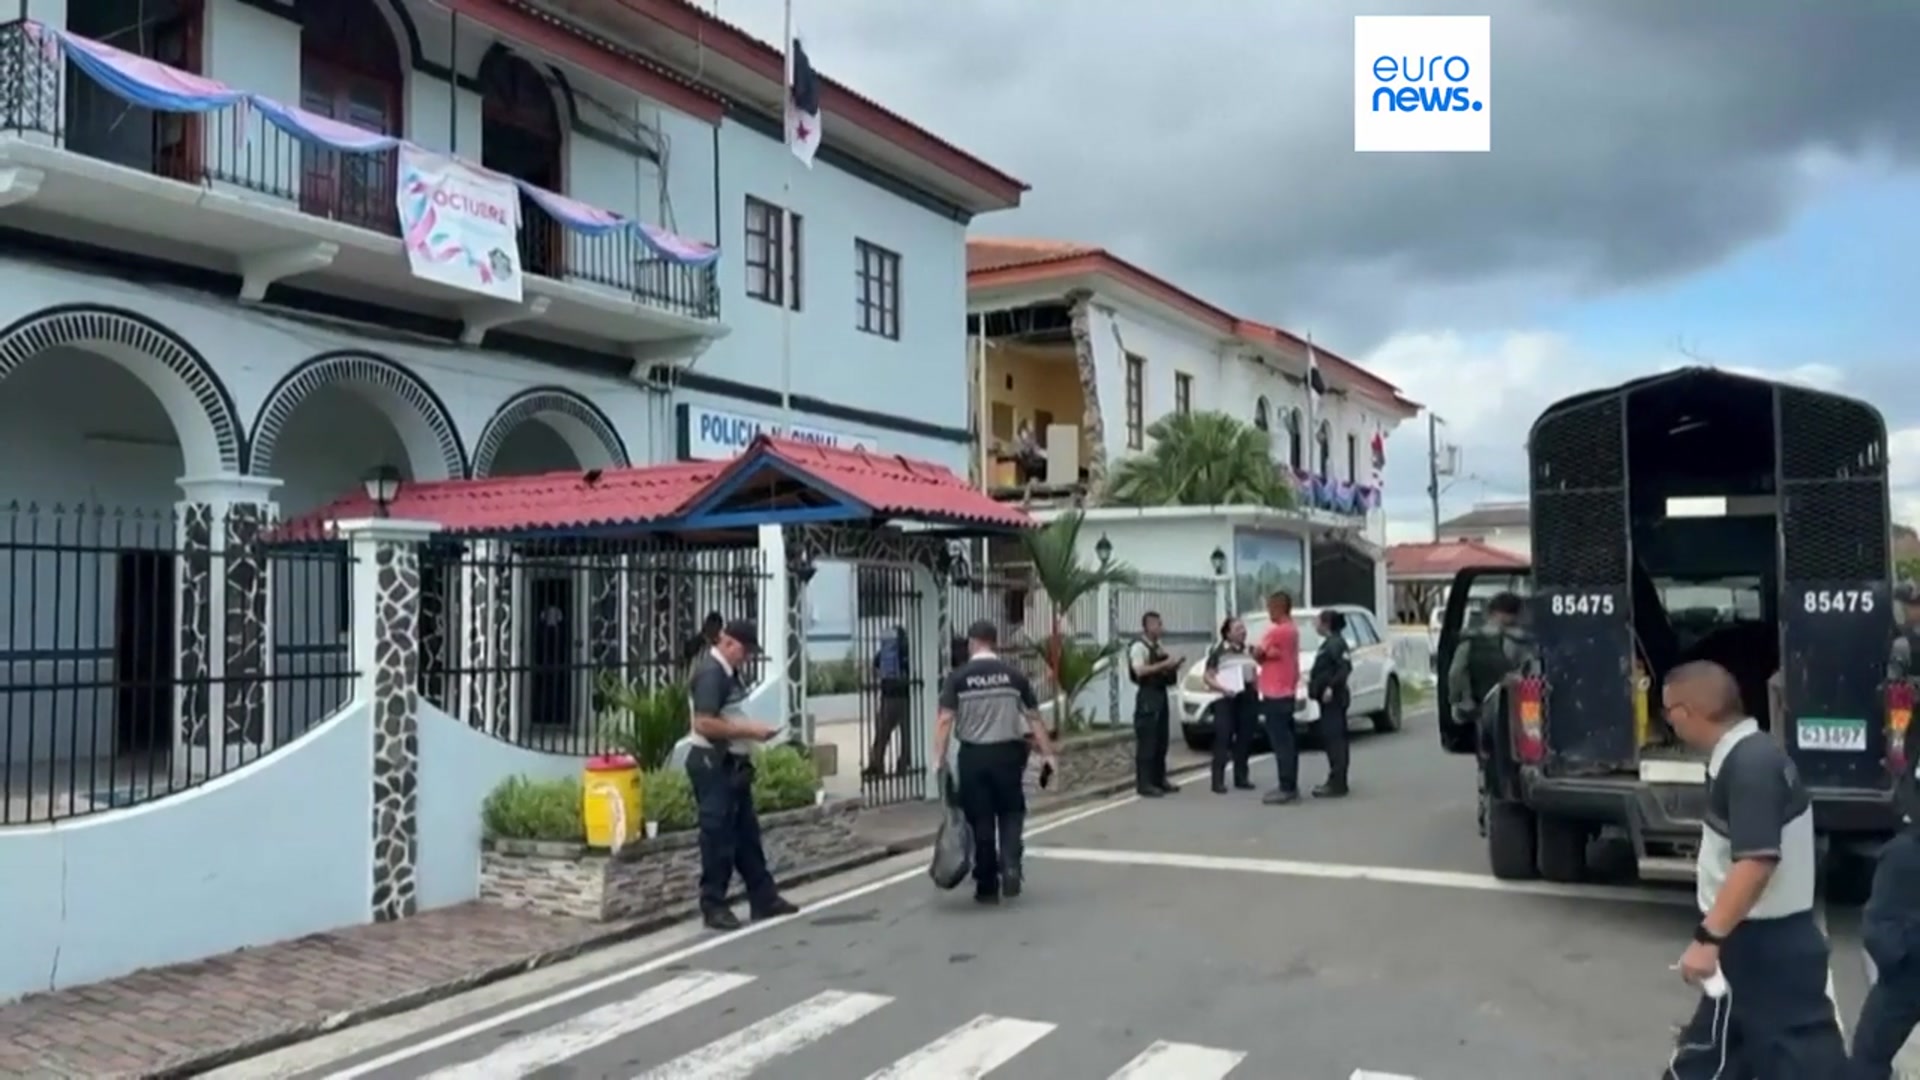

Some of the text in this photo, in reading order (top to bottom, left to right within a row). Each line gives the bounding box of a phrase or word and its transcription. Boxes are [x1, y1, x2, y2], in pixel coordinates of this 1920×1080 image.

[433, 189, 507, 226] OCTUBRE
[1552, 594, 1614, 615] 85475
[1804, 590, 1874, 613] 85475
[966, 673, 1010, 687] POLICIA
